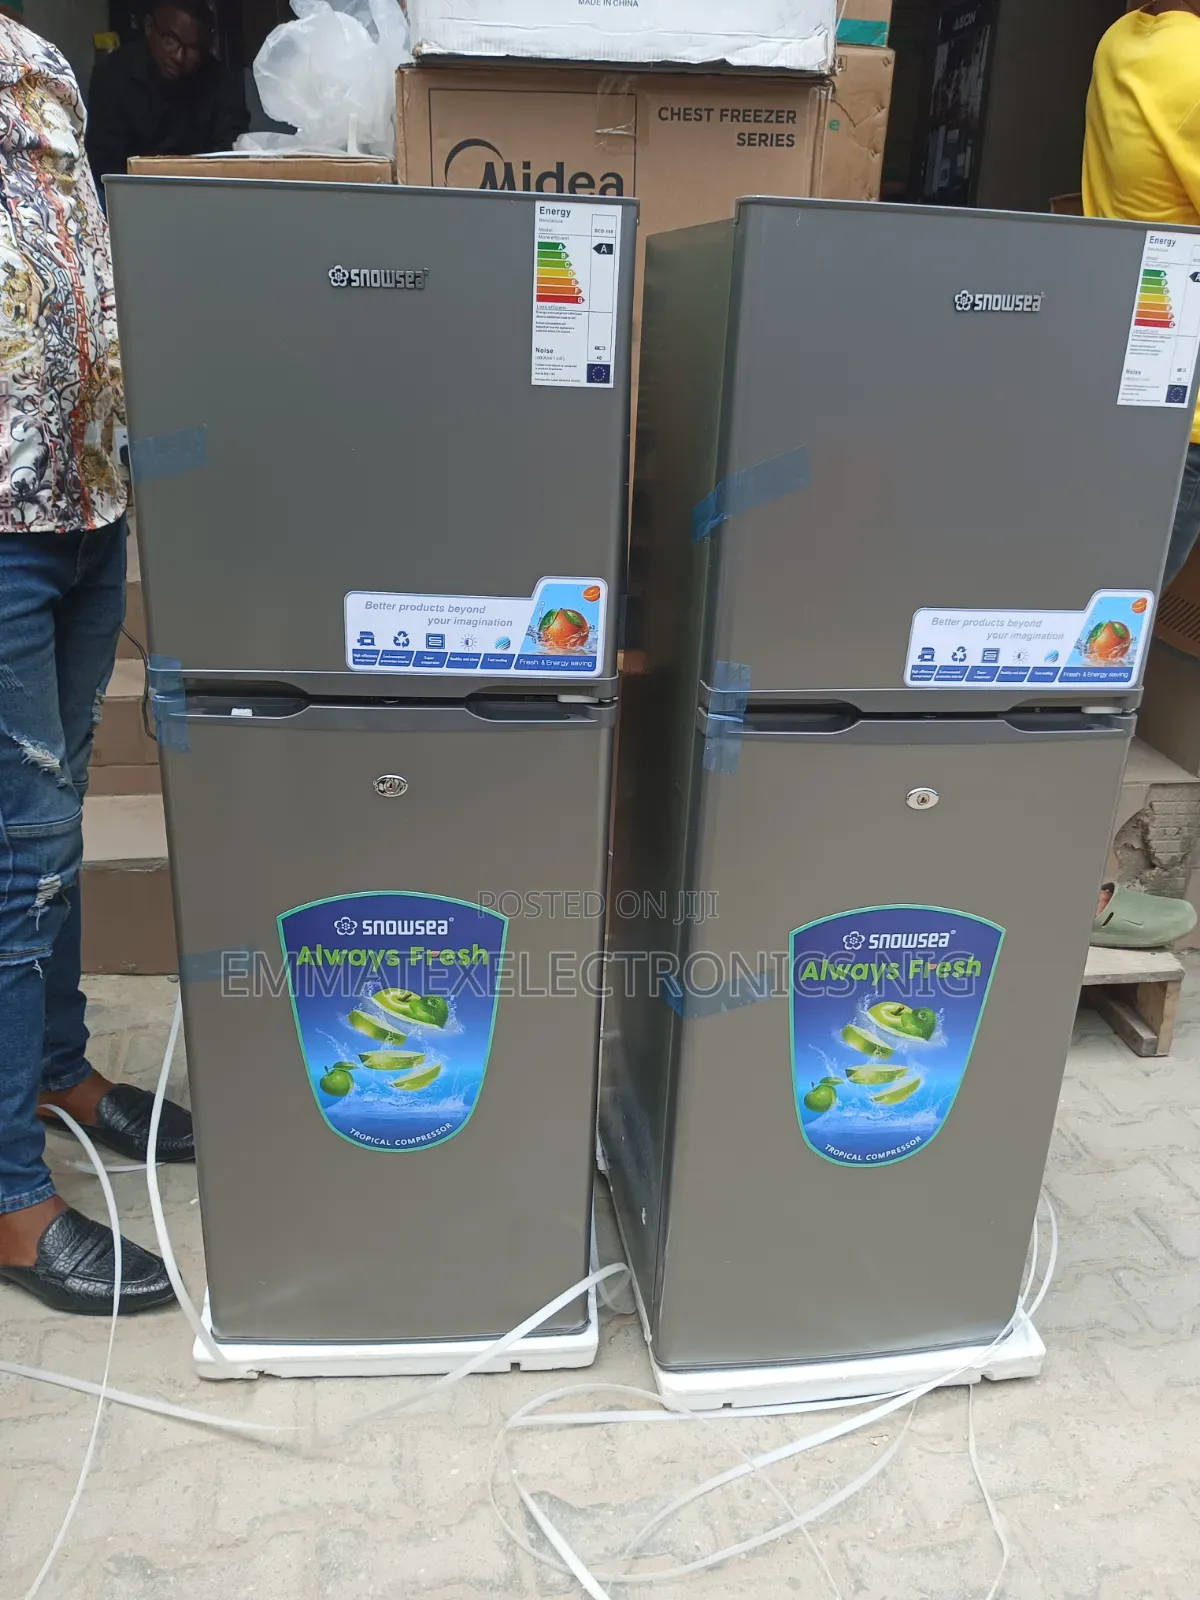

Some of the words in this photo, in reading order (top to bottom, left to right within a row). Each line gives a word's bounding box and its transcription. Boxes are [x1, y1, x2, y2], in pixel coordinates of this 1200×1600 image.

[658, 106, 714, 122] CHEST
[719, 108, 797, 124] FREEZER
[736, 132, 796, 148] SERIES
[479, 161, 624, 197] Midea
[539, 206, 572, 218] Energy
[1149, 235, 1177, 247] Energy
[600, 244, 608, 254] A
[365, 600, 397, 611] Better
[399, 603, 445, 614] products
[447, 603, 487, 614] beyond
[427, 617, 452, 627] your
[453, 617, 514, 628] imagination
[931, 616, 960, 627] Better
[962, 618, 1005, 629] products
[1007, 618, 1042, 630] beyond
[986, 631, 1009, 641] your
[1010, 631, 1065, 642] imagination
[546, 659, 570, 668] Energy
[570, 660, 593, 668] saving
[1087, 671, 1108, 679] Energy
[297, 945, 400, 973] Always
[410, 945, 489, 967] Fresh
[801, 957, 899, 986] Always
[908, 956, 982, 979] Fresh
[349, 1127, 391, 1146] TROPICAL
[394, 1122, 452, 1146] COMPRESSOR
[824, 1143, 862, 1161] TROPICAL
[865, 1135, 922, 1161] COMPRESSOR
